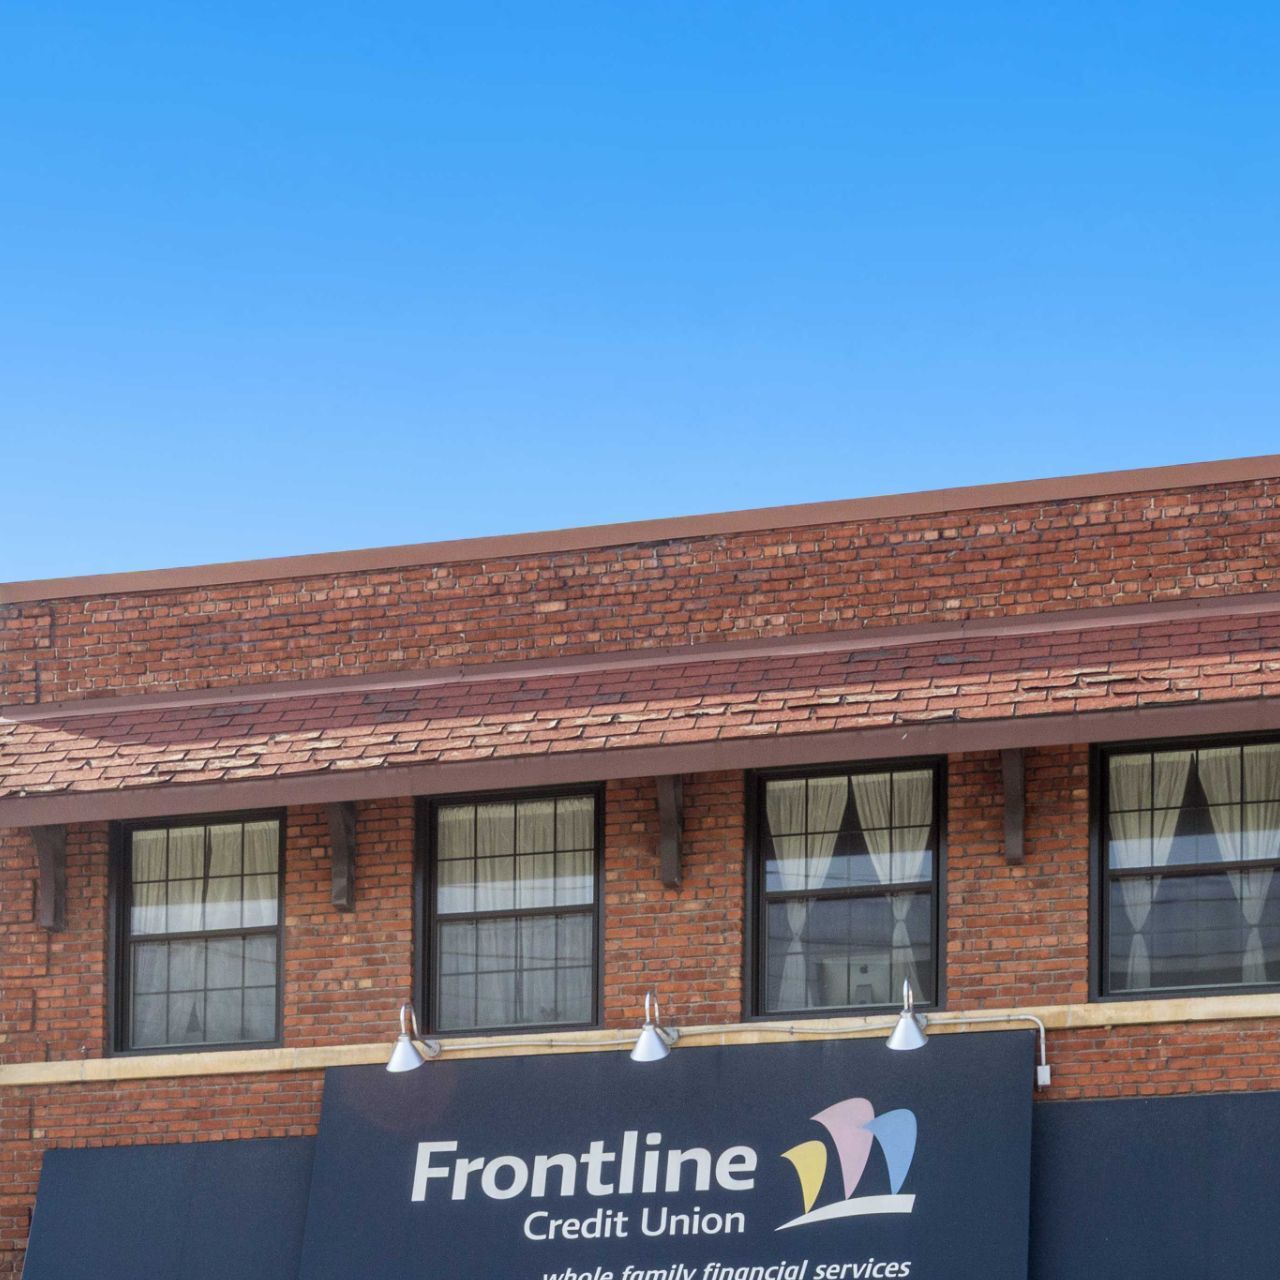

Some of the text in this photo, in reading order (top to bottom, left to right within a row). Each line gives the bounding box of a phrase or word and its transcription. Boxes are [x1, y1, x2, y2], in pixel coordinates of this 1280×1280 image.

[411, 1130, 758, 1201] Frontline
[523, 1207, 745, 1240] Credit Union
